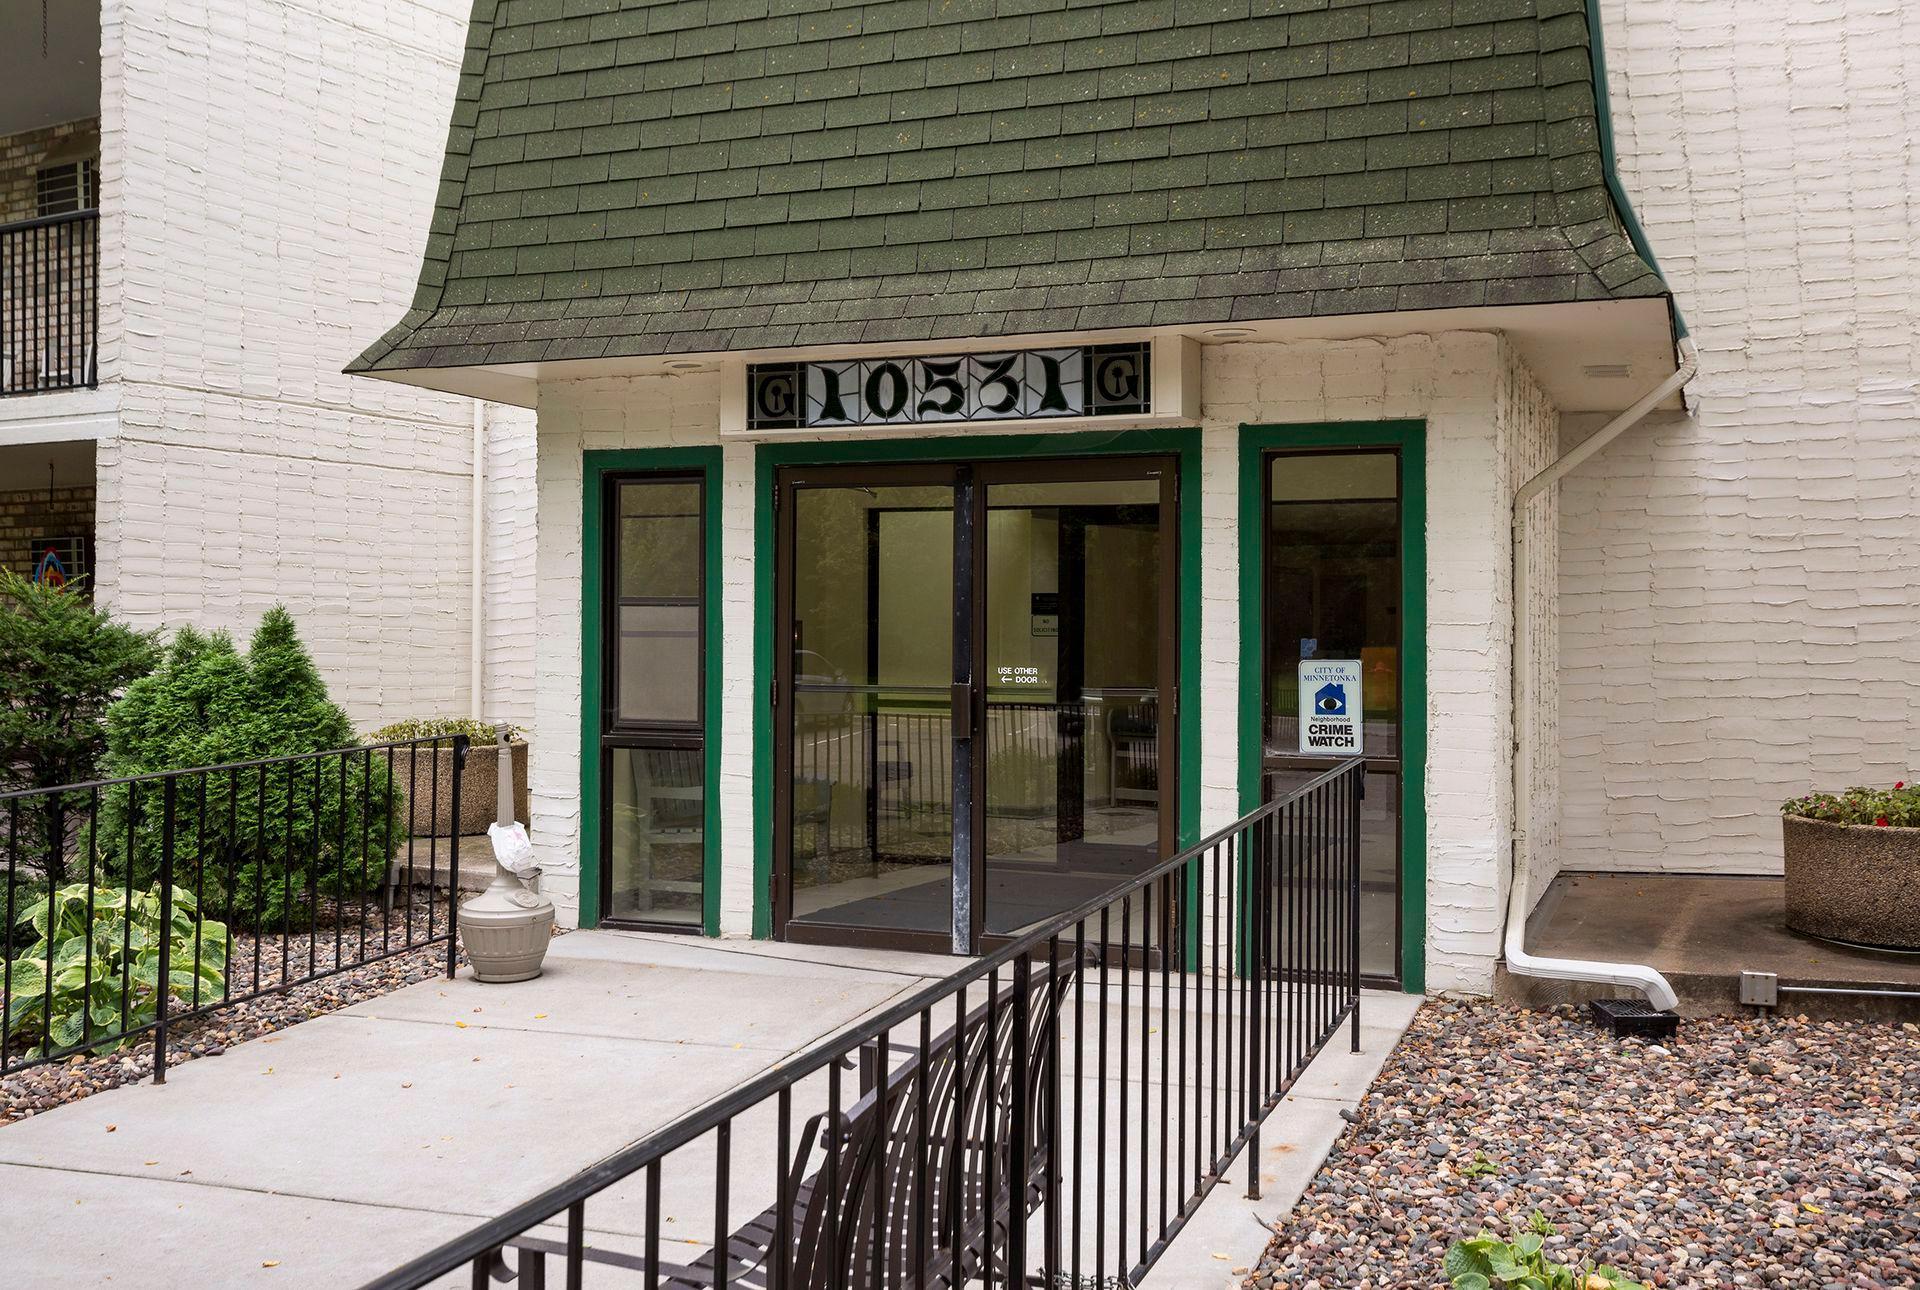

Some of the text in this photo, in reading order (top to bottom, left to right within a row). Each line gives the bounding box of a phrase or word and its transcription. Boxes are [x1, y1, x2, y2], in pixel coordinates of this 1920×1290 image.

[819, 353, 1069, 421] 10531
[997, 667, 1038, 675] USE OTHER
[1308, 724, 1353, 735] CRIME
[1308, 736, 1354, 747] WATCH
